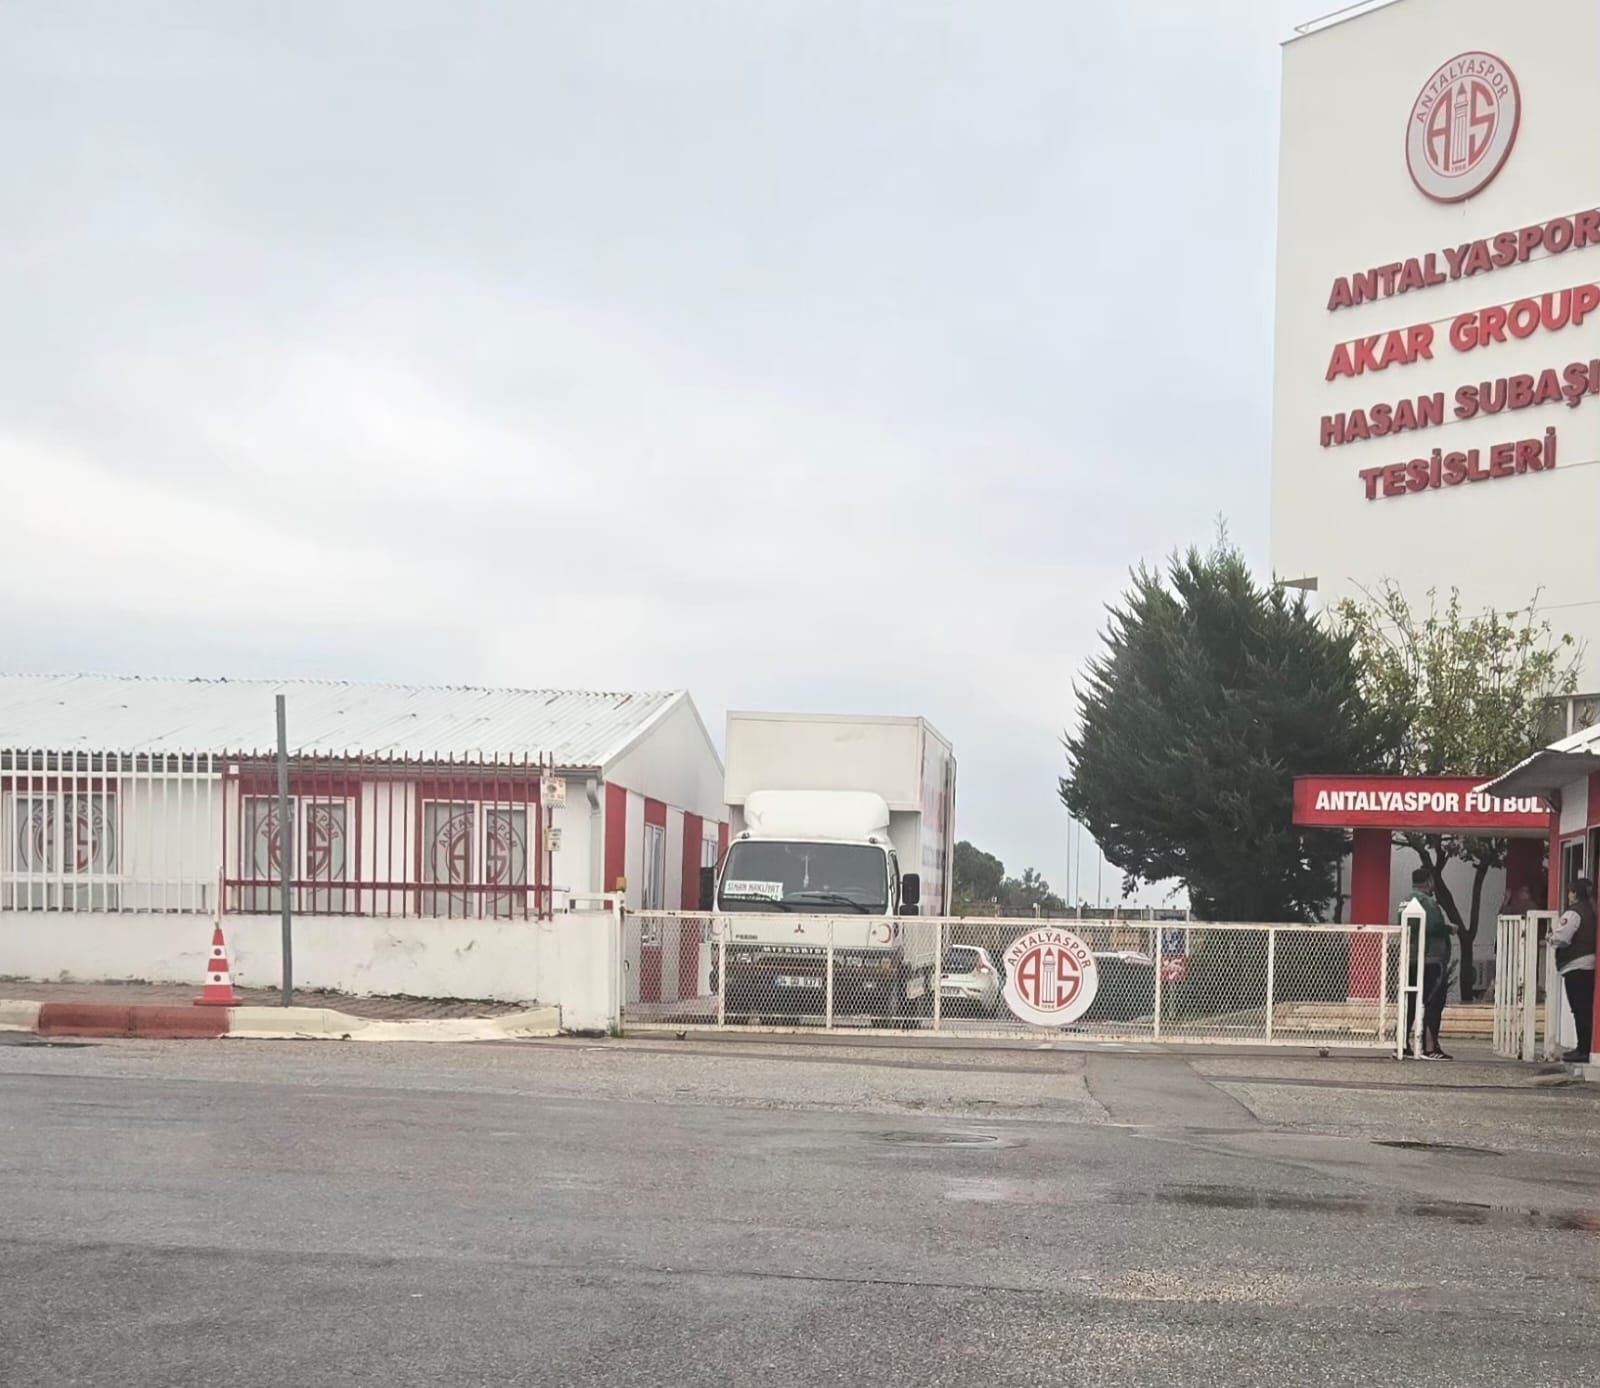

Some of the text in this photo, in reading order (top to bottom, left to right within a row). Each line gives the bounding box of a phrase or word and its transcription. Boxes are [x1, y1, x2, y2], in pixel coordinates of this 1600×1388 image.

[1416, 60, 1508, 123] ANTALYASPOR
[1327, 208, 1600, 311] ANTALYASPOR
[1325, 283, 1600, 381] AKAR GROUP
[1320, 359, 1600, 447] HASAN SUBAŞI
[1359, 426, 1556, 500] TESİSLERİ
[1315, 791, 1458, 812] ANTALYASPOR
[1008, 932, 1091, 968] ANTALYASPOR
